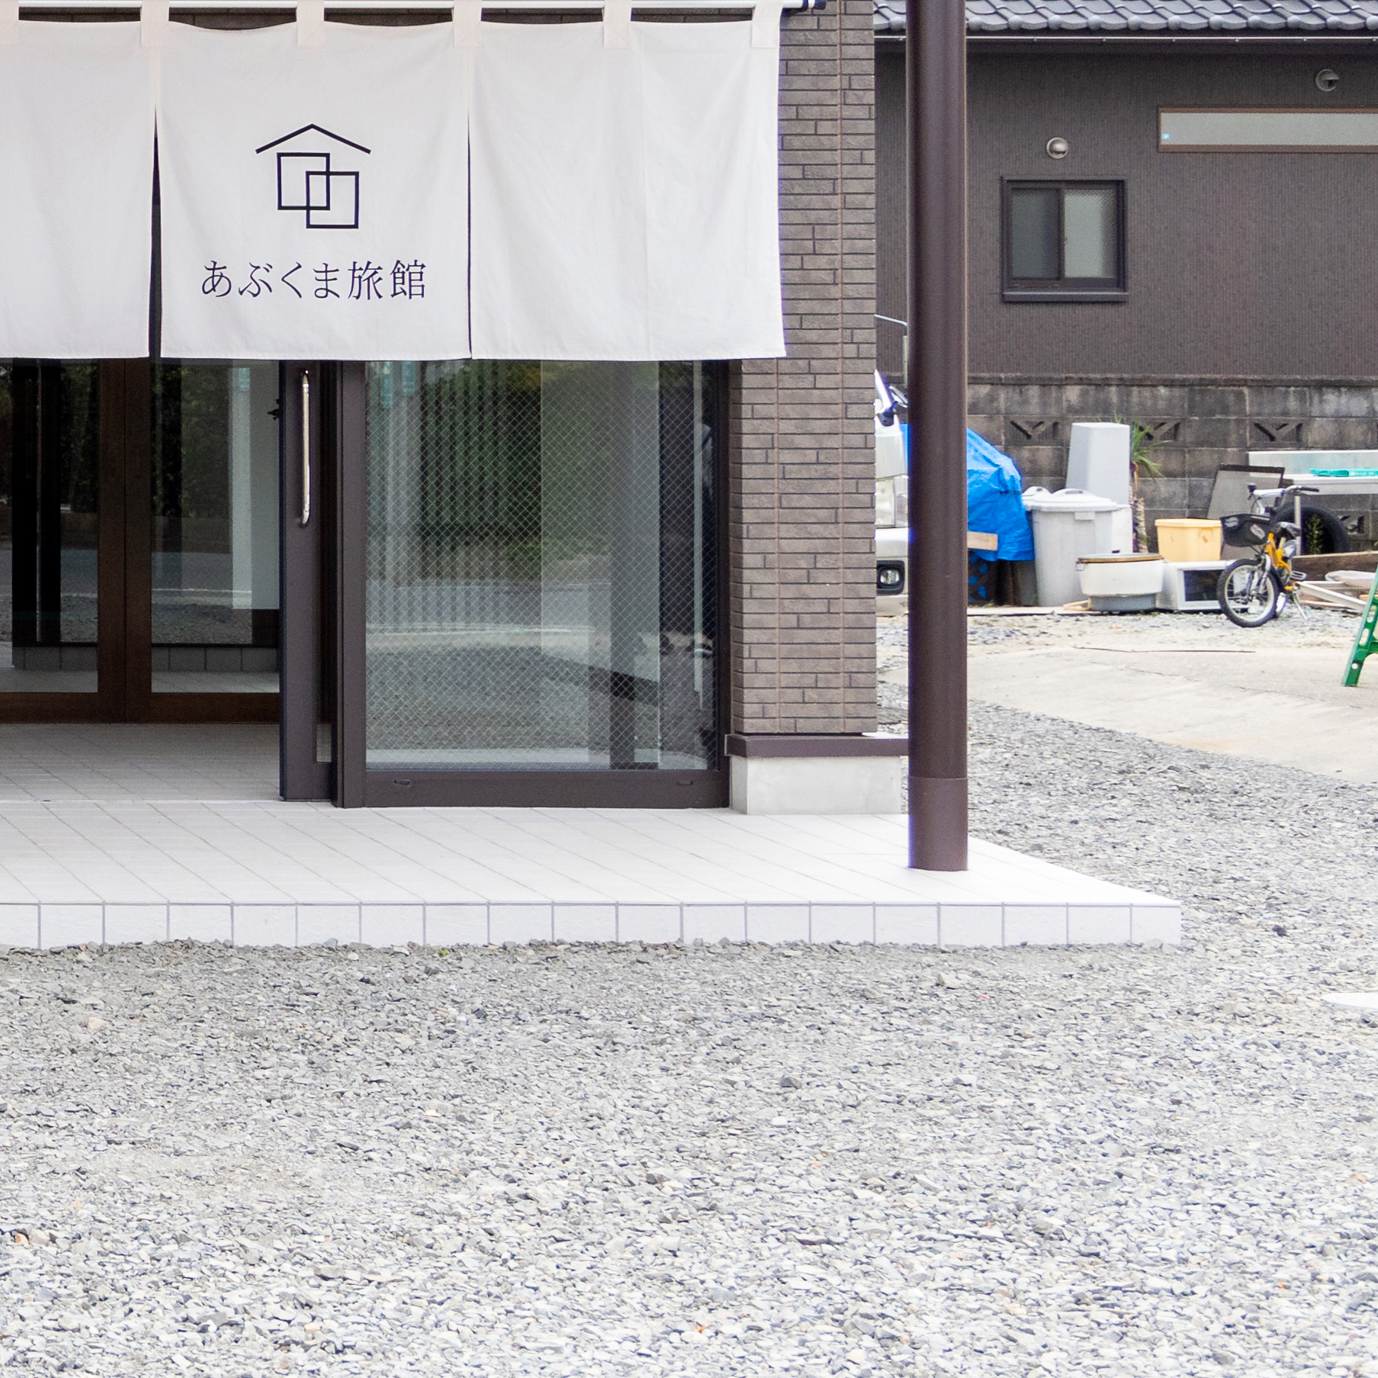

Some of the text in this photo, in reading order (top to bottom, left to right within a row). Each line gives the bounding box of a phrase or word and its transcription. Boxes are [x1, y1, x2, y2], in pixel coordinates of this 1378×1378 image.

[200, 258, 427, 301] あぶくま旅館
